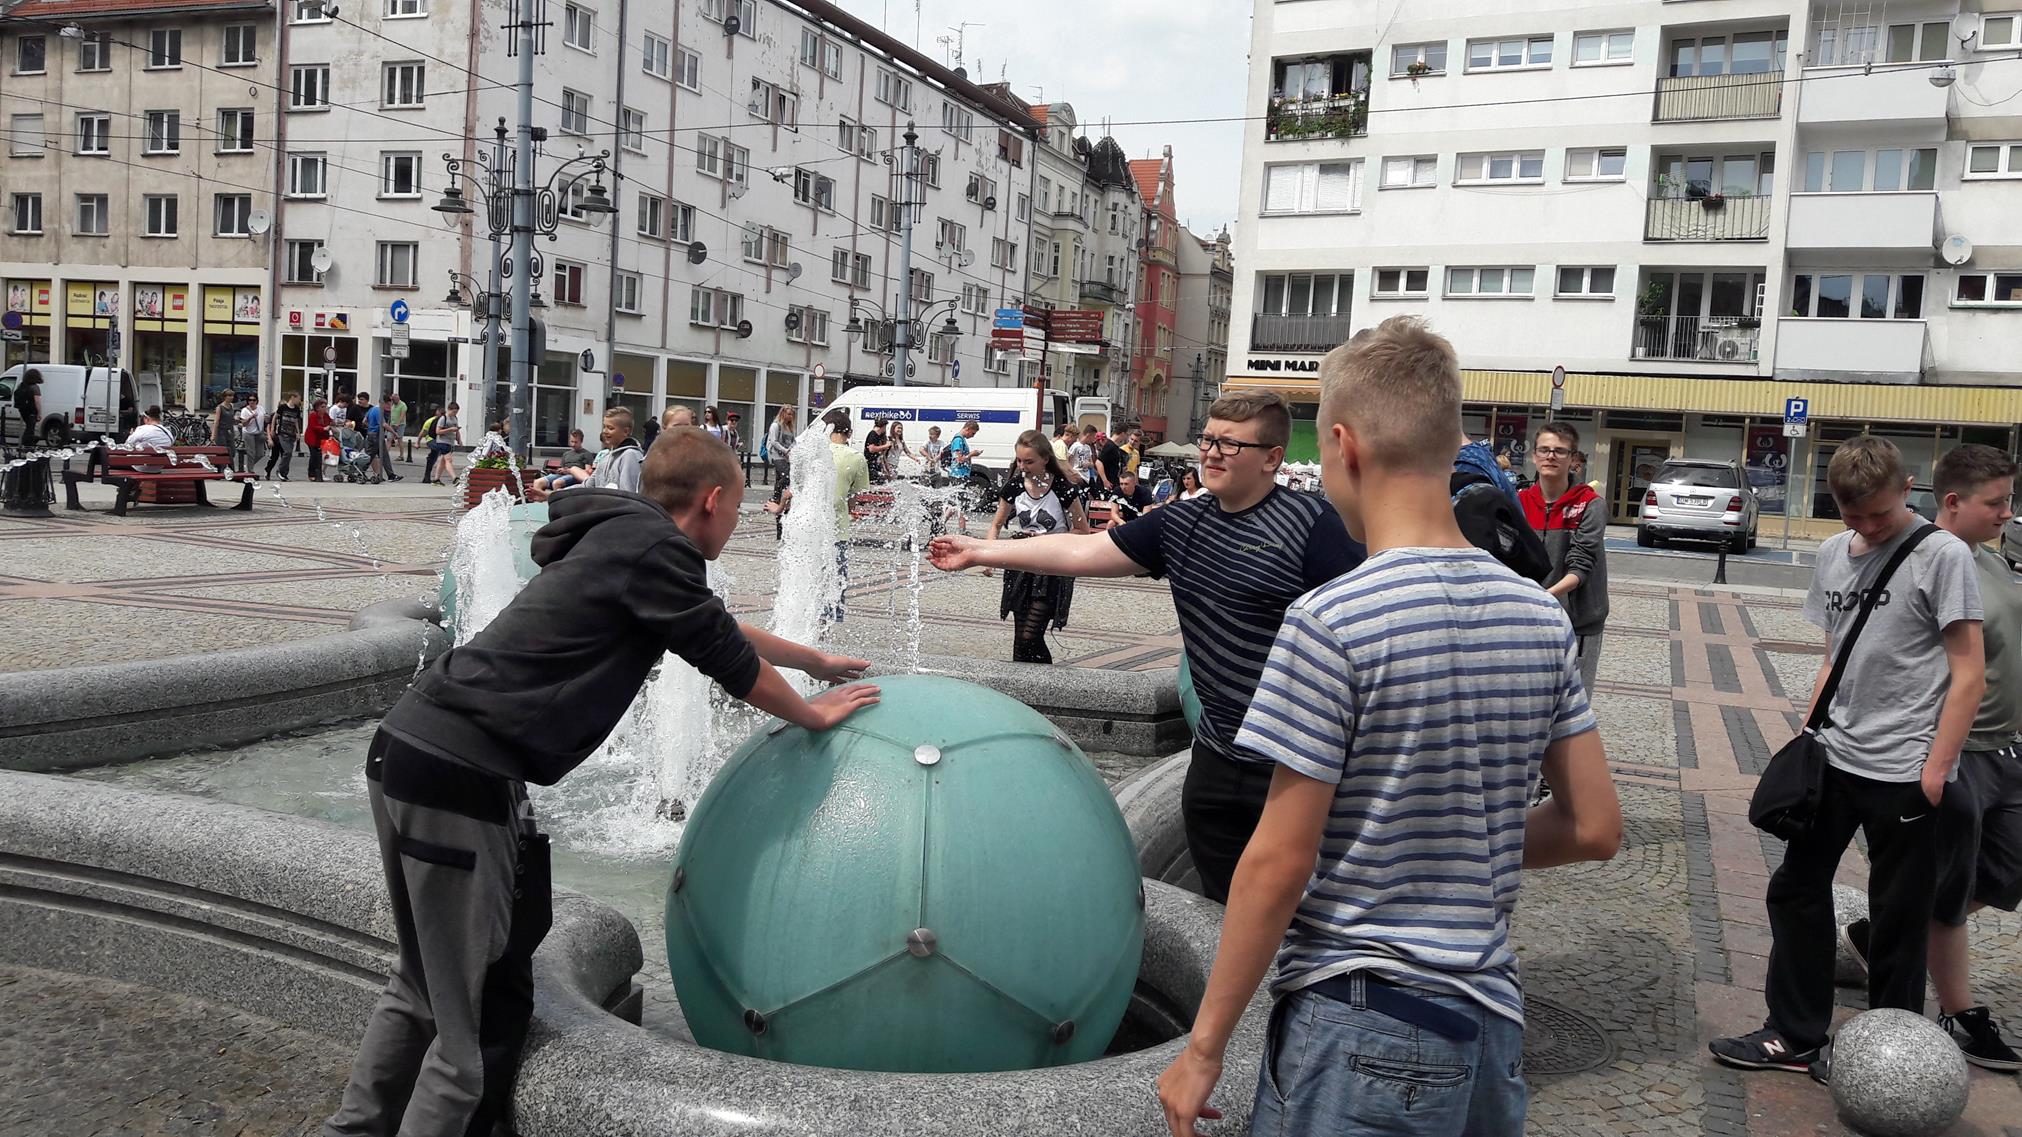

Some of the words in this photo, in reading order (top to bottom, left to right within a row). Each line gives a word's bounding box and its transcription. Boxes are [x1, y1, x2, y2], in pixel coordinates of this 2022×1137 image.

[1247, 360, 1281, 371] MINI
[1790, 401, 1804, 417] P
[956, 412, 980, 420] SERWIS
[1763, 1040, 1785, 1055] N
